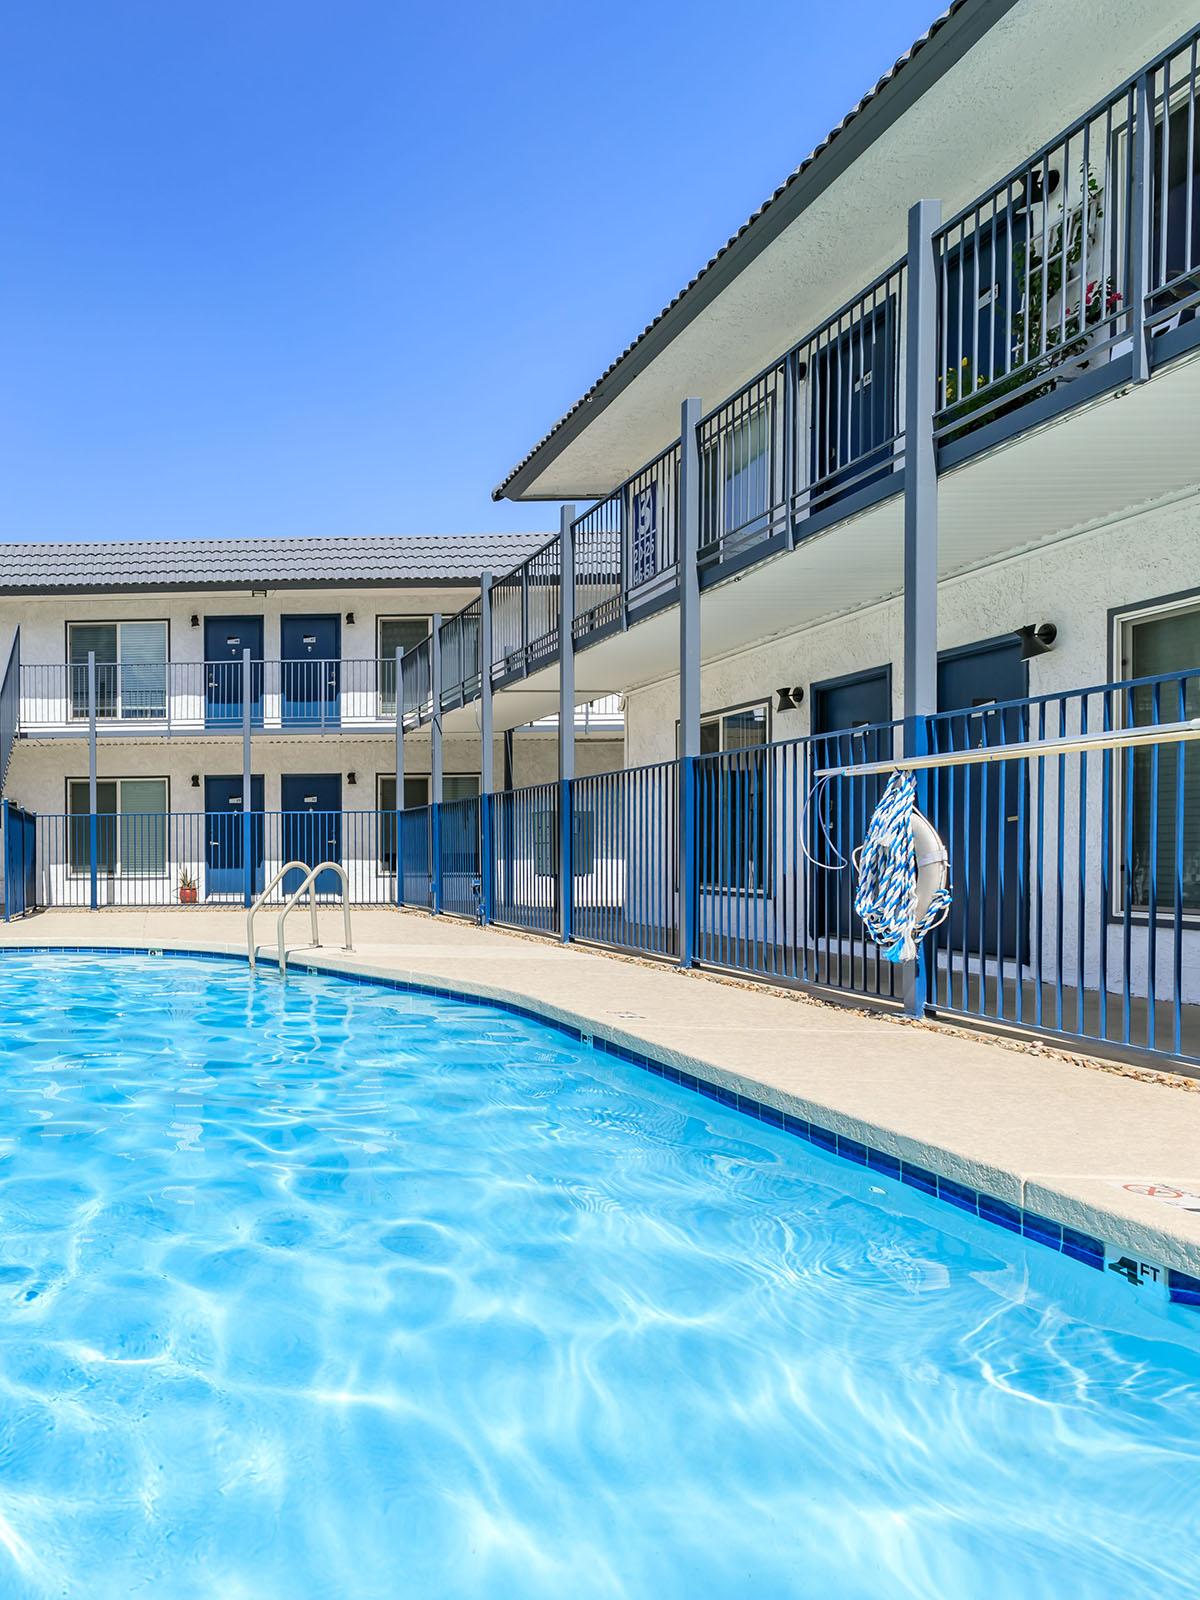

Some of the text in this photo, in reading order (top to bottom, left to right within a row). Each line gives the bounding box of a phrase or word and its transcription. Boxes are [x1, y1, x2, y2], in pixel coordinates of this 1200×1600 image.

[637, 487, 652, 535] 3
[1108, 1256, 1160, 1287] 4 FT
